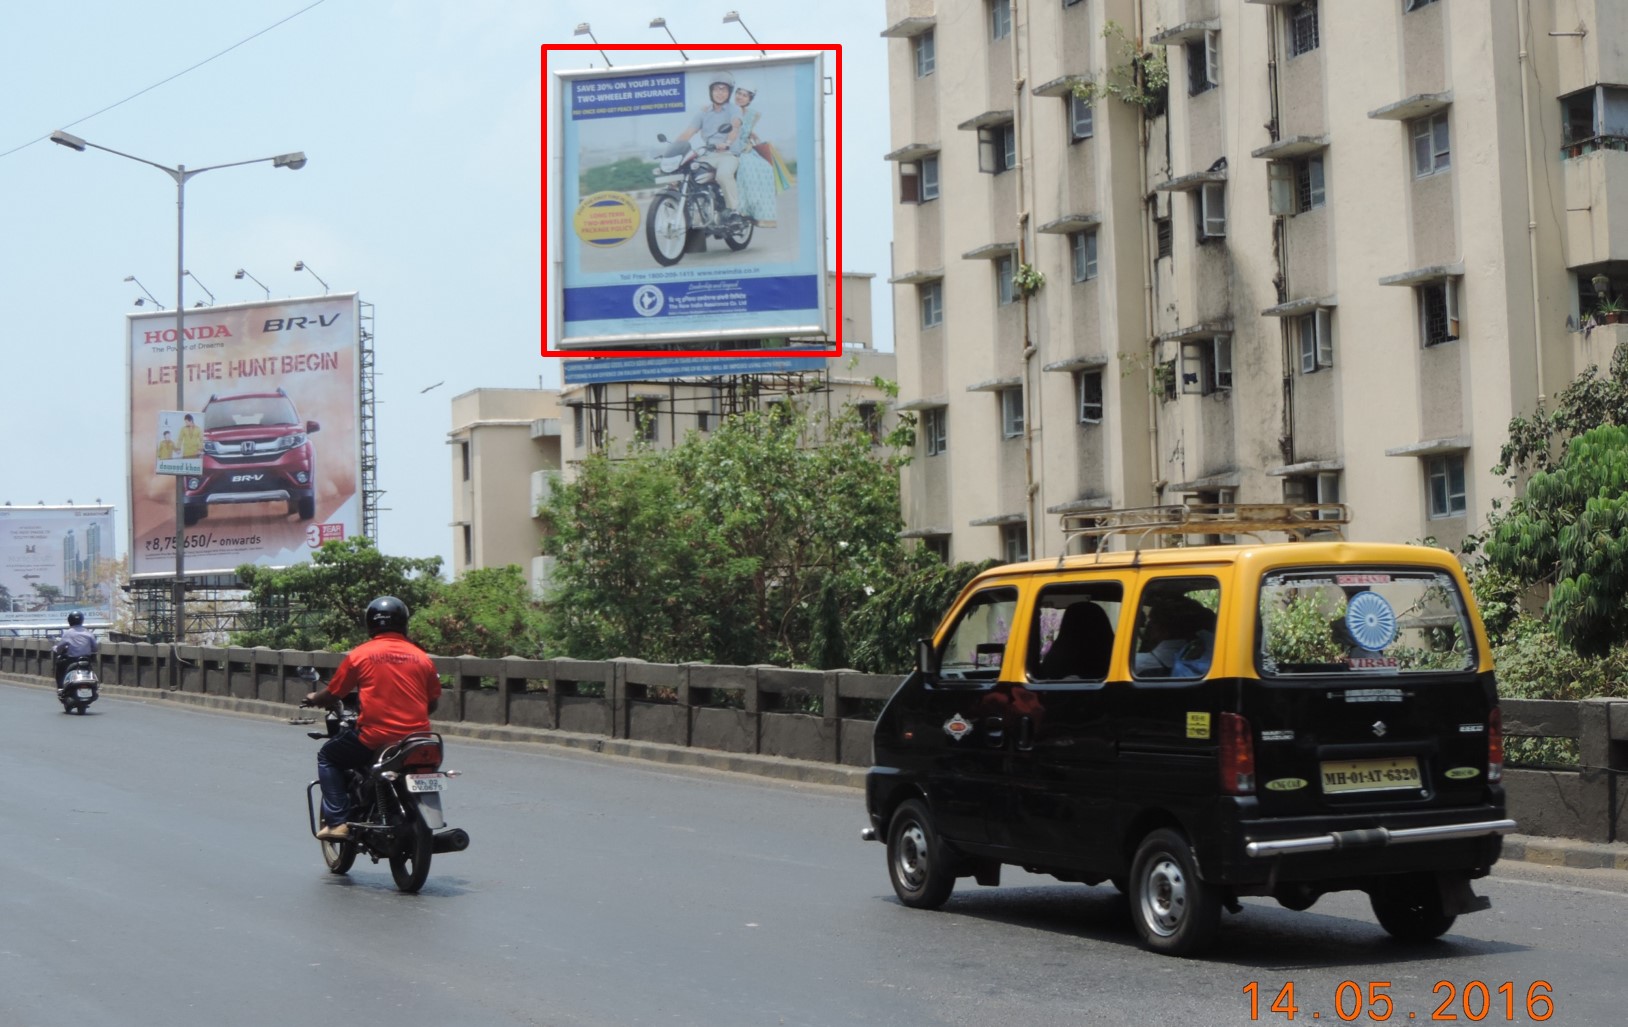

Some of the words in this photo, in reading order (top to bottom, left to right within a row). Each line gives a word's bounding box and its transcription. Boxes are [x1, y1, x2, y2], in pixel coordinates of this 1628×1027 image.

[577, 84, 596, 92] SAVE
[597, 83, 614, 91] 30%
[614, 82, 626, 90] ON
[628, 80, 650, 88] YOUR
[650, 79, 655, 87] 3
[656, 78, 680, 86] YEARS
[577, 92, 633, 103] TWO-WHEELER
[634, 88, 680, 99] INSURANCE.
[263, 313, 341, 333] BR-V
[144, 325, 232, 344] HONDA
[186, 362, 222, 382] THE
[228, 357, 278, 378] HUNT
[281, 352, 338, 374] BEGIN
[232, 474, 264, 482] BR-V
[145, 533, 218, 552] ₹8,75650/-
[220, 535, 262, 546] onwards
[306, 524, 320, 548] 3
[322, 525, 342, 534] YEAR
[1325, 768, 1418, 785] MH-01-AT-6320
